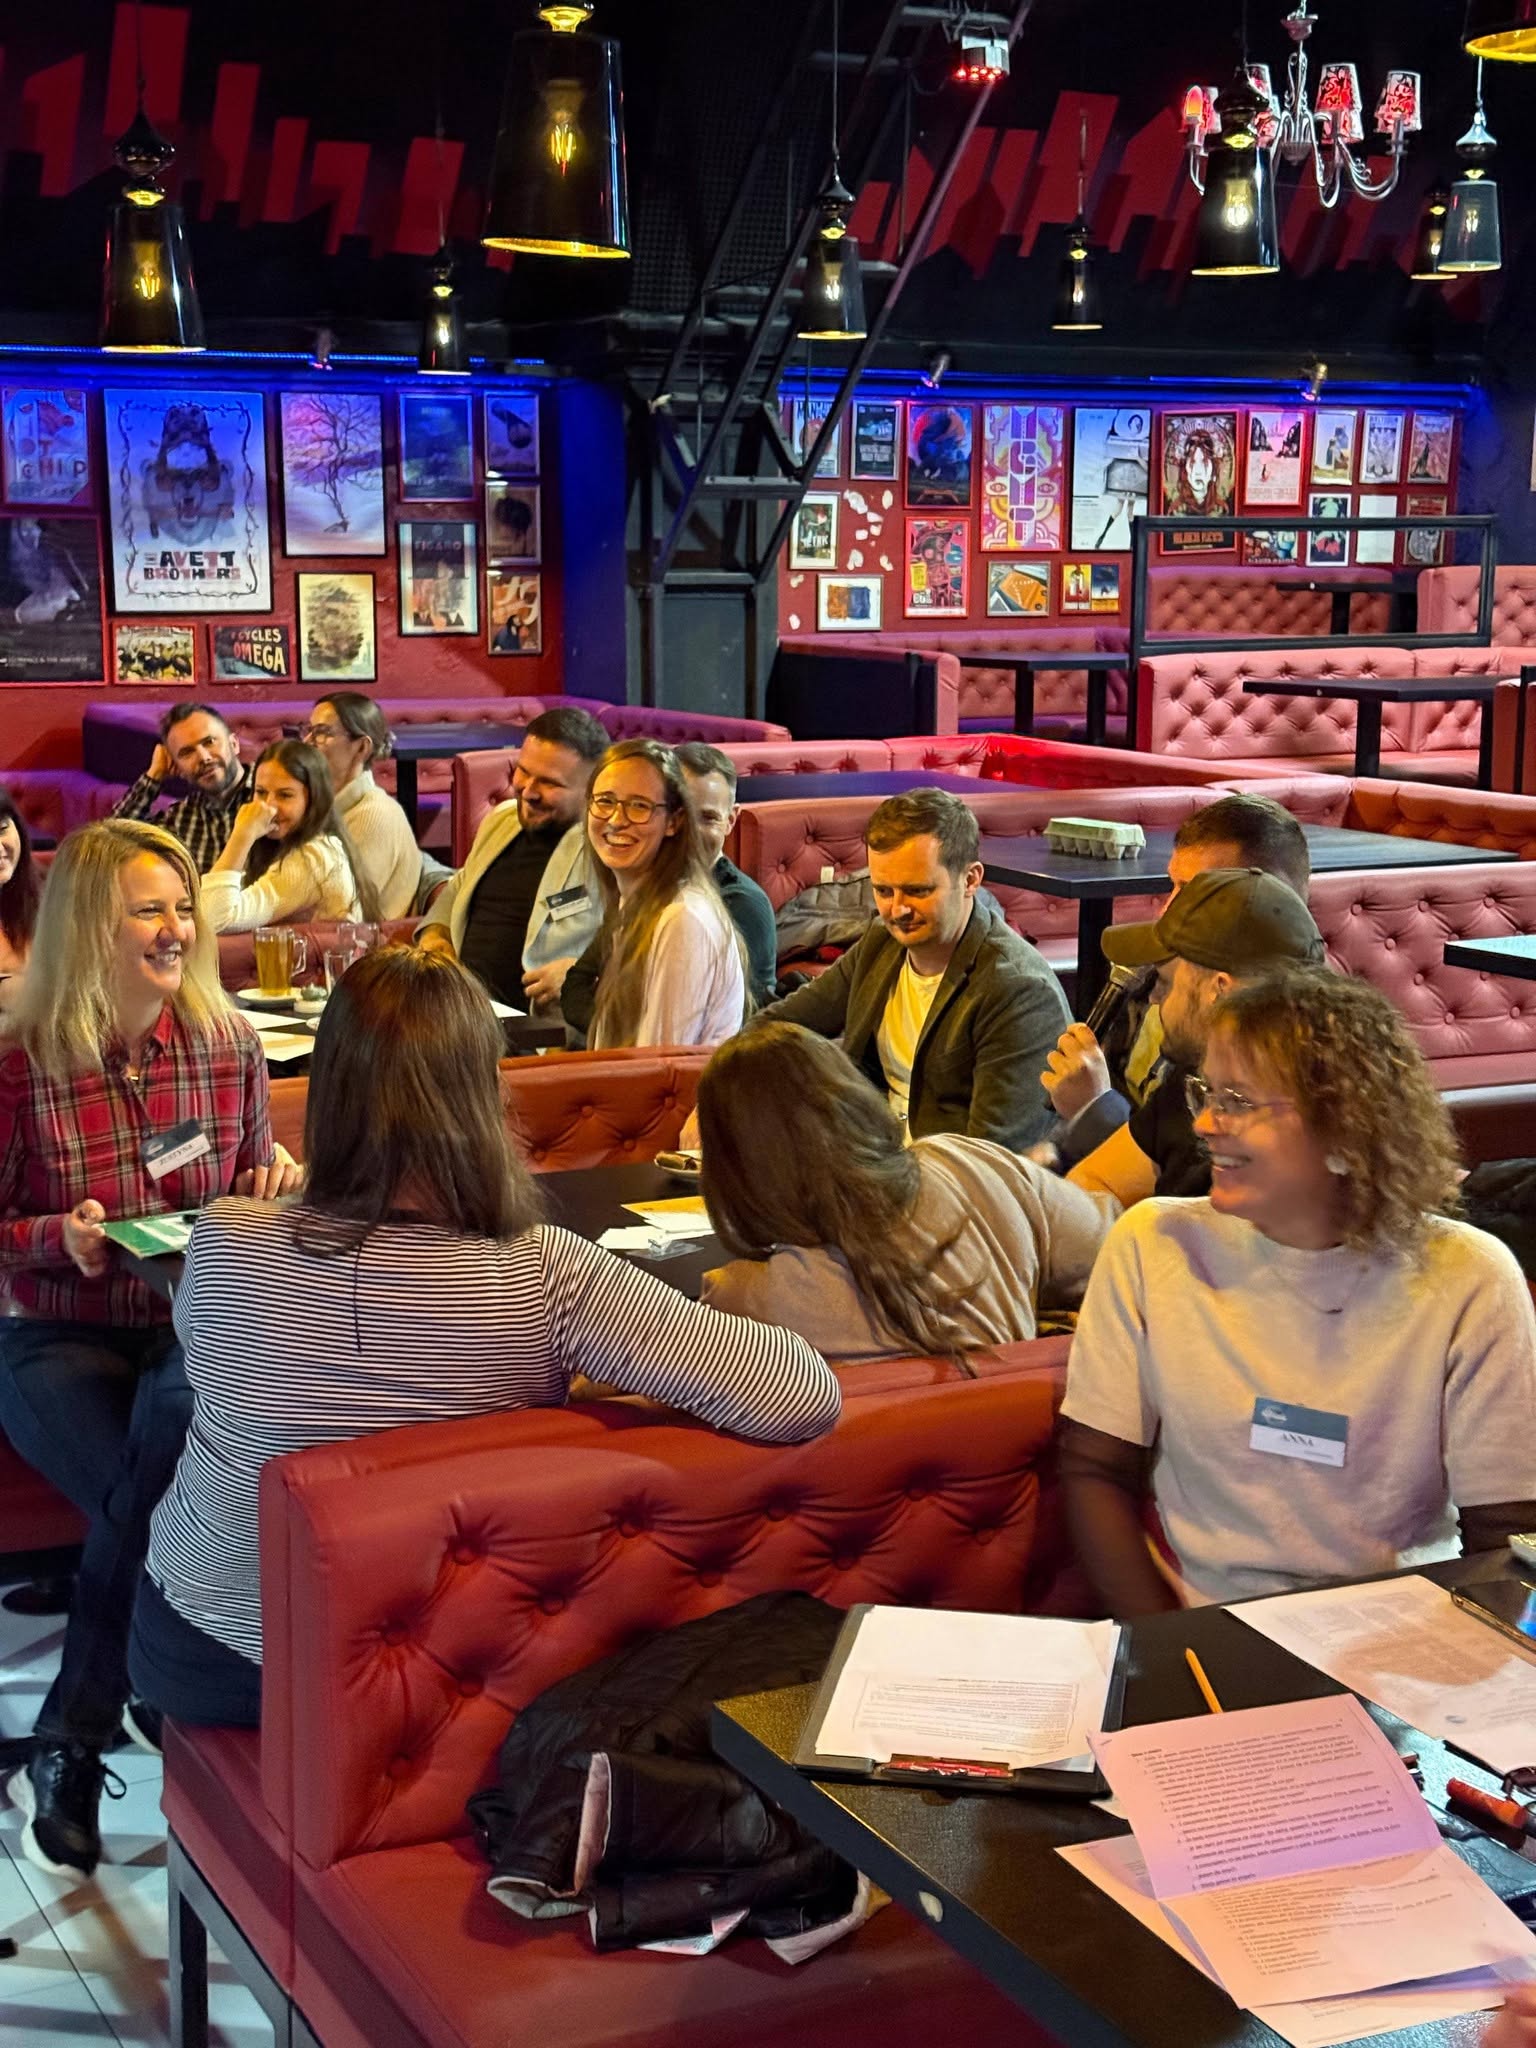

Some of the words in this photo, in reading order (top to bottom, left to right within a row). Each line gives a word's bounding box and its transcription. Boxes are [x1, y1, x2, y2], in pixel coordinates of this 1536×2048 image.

[160, 551, 235, 567] AVETT
[143, 567, 241, 580] BROTHERS
[233, 641, 287, 675] OMEGA
